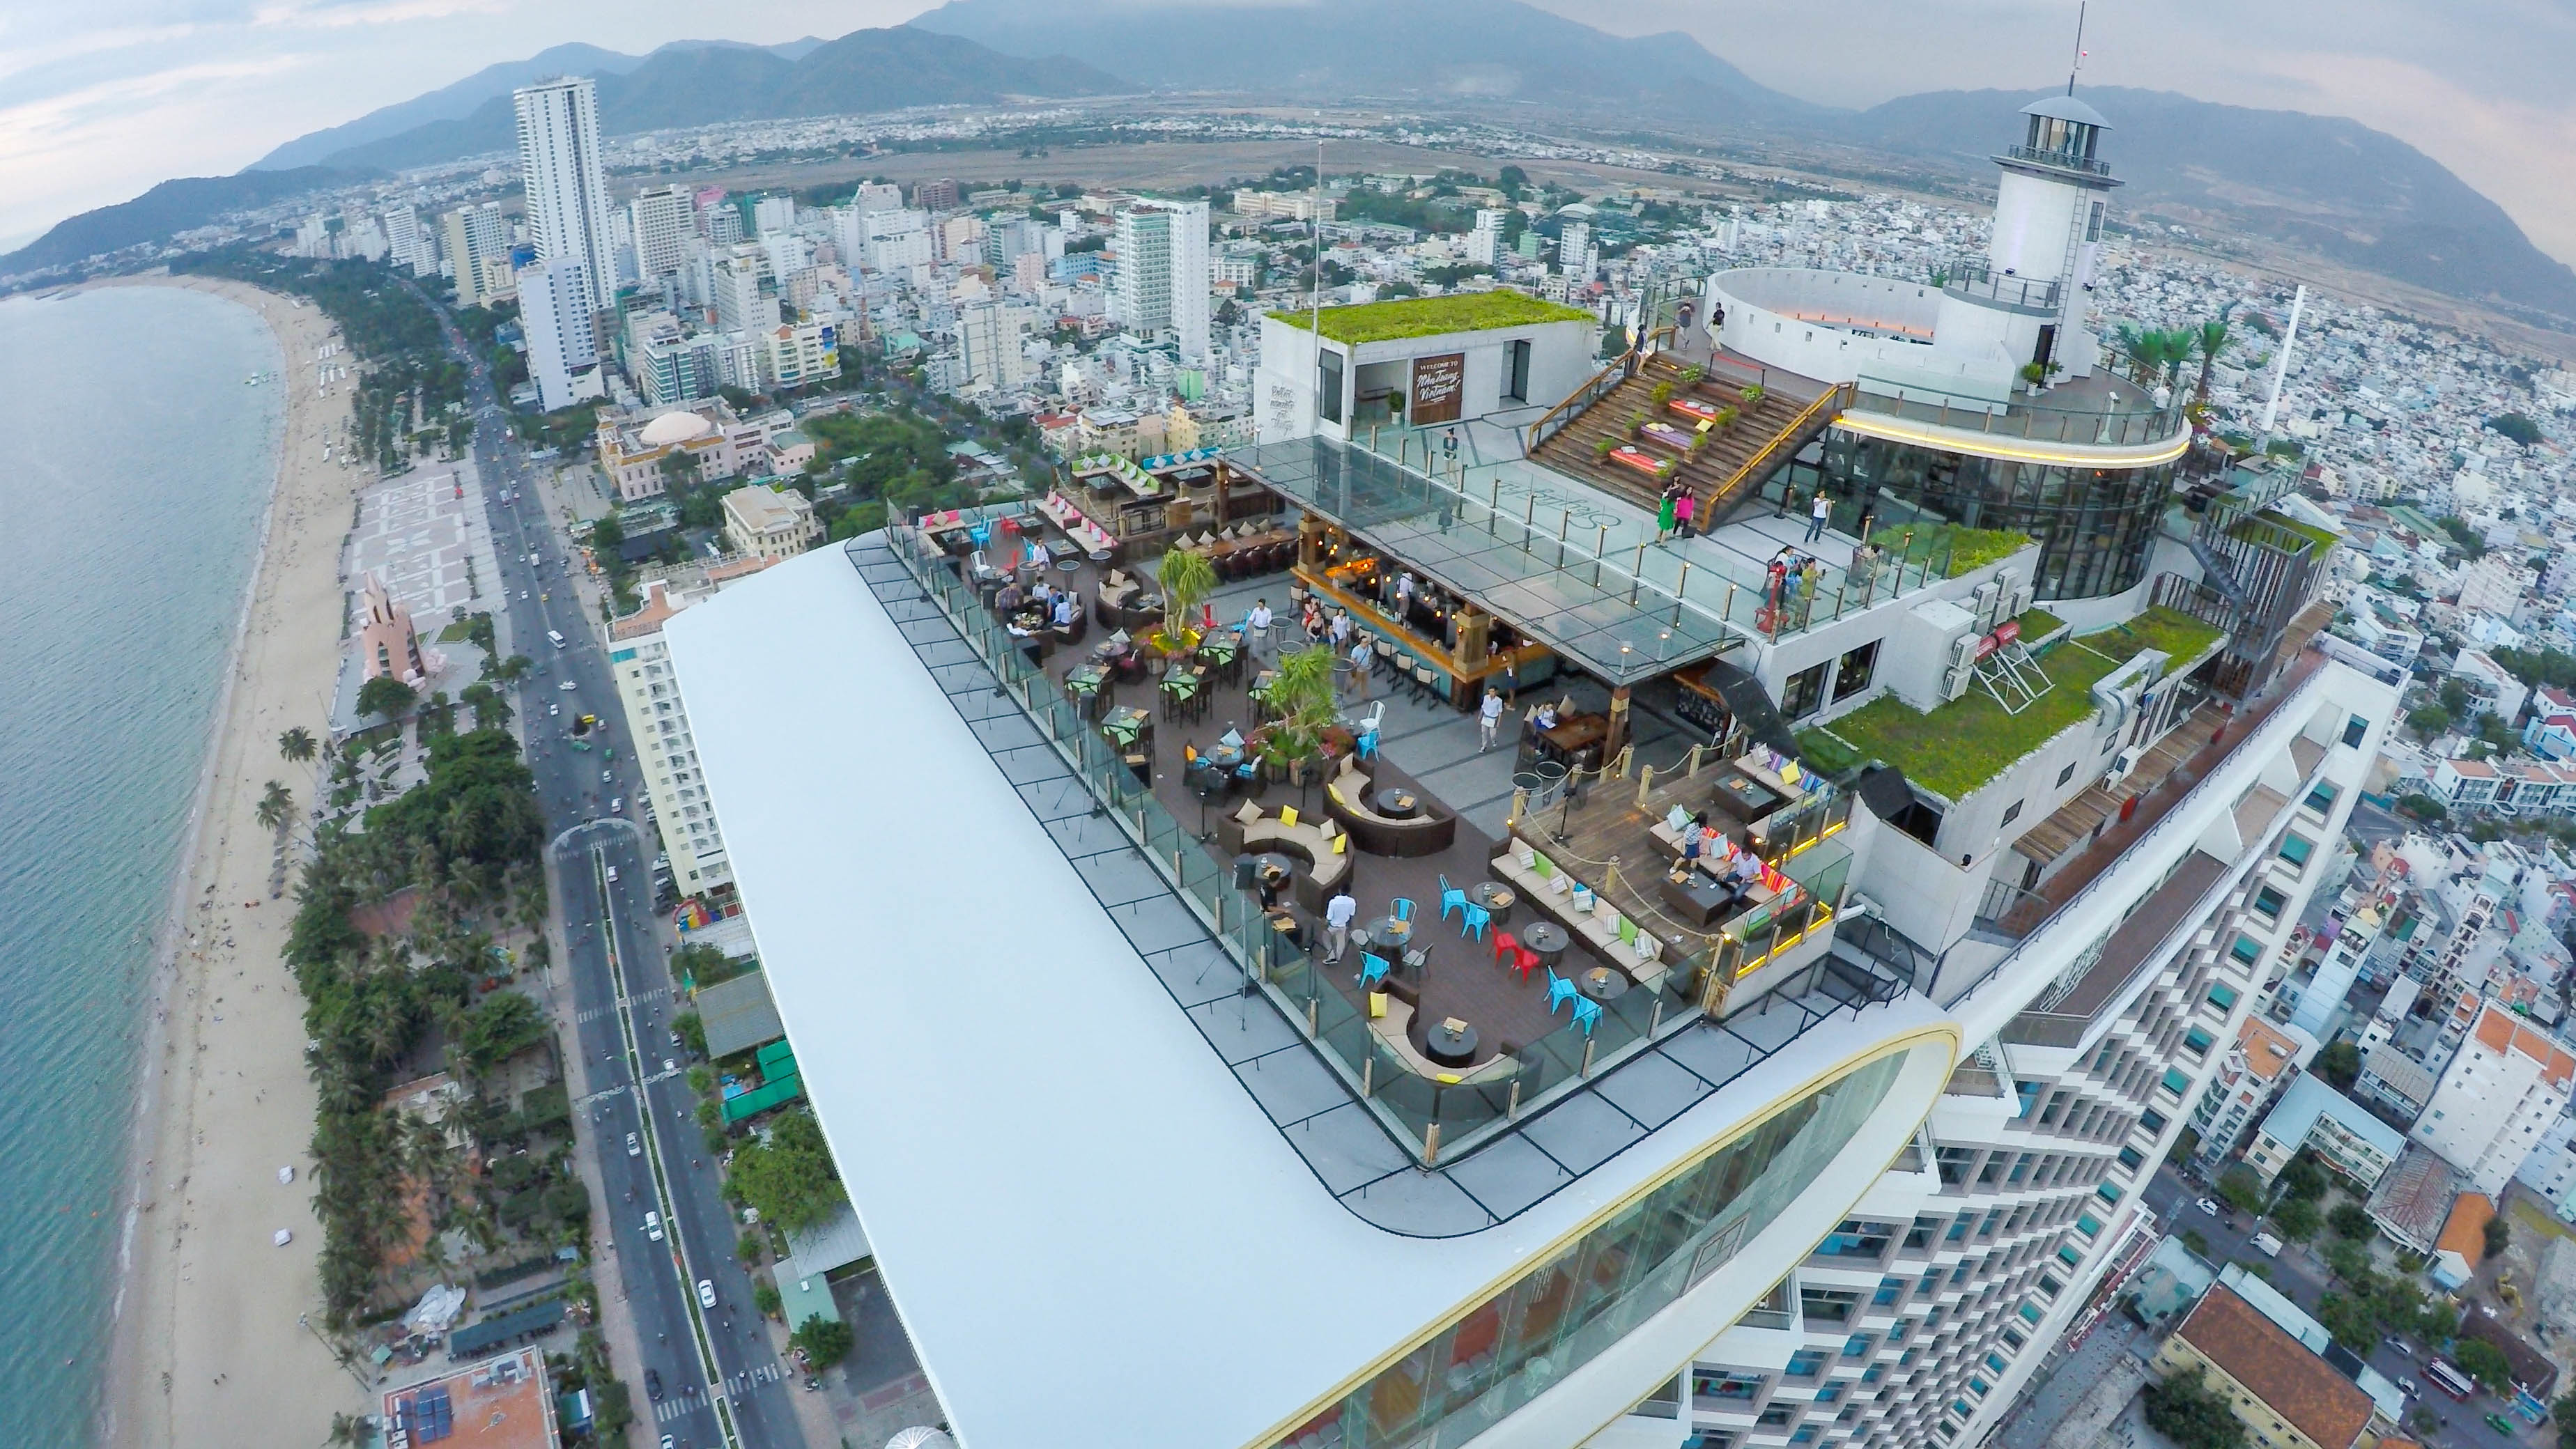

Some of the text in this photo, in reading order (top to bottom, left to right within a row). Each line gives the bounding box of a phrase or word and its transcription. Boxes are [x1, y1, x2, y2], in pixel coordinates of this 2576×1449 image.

[1420, 362, 1449, 370] WELCOME
[1417, 373, 1435, 388] Nha
[1498, 483, 1621, 529] Skylight
